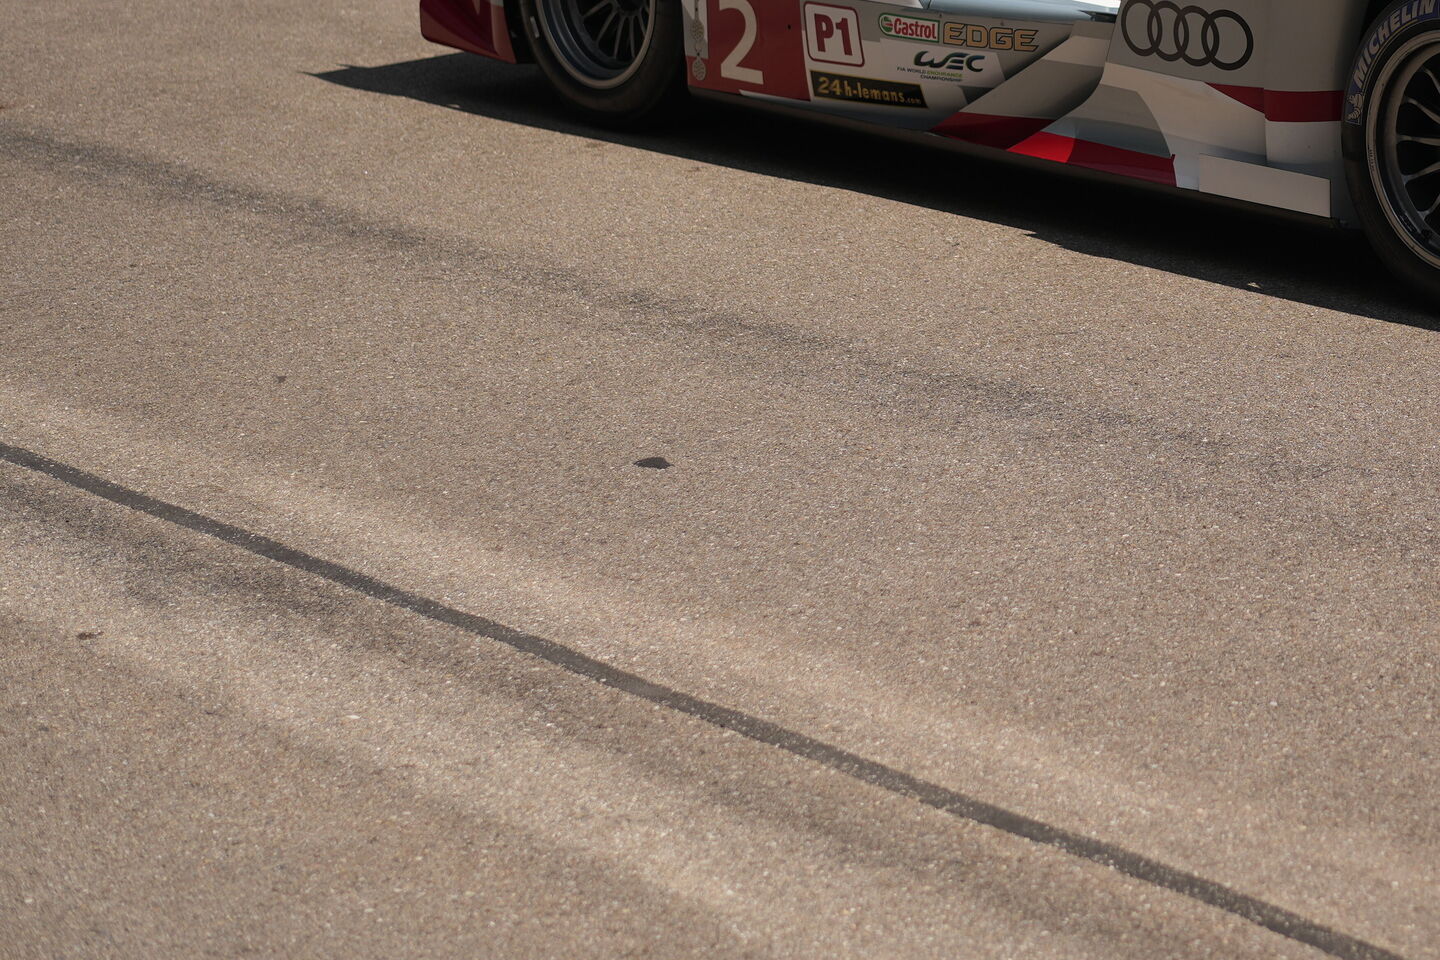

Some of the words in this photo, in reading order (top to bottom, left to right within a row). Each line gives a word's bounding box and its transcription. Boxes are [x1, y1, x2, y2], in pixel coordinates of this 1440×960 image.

[813, 13, 853, 56] P1
[893, 17, 937, 40] Castrol
[942, 20, 1040, 52] EDGE
[913, 50, 986, 73] WEC
